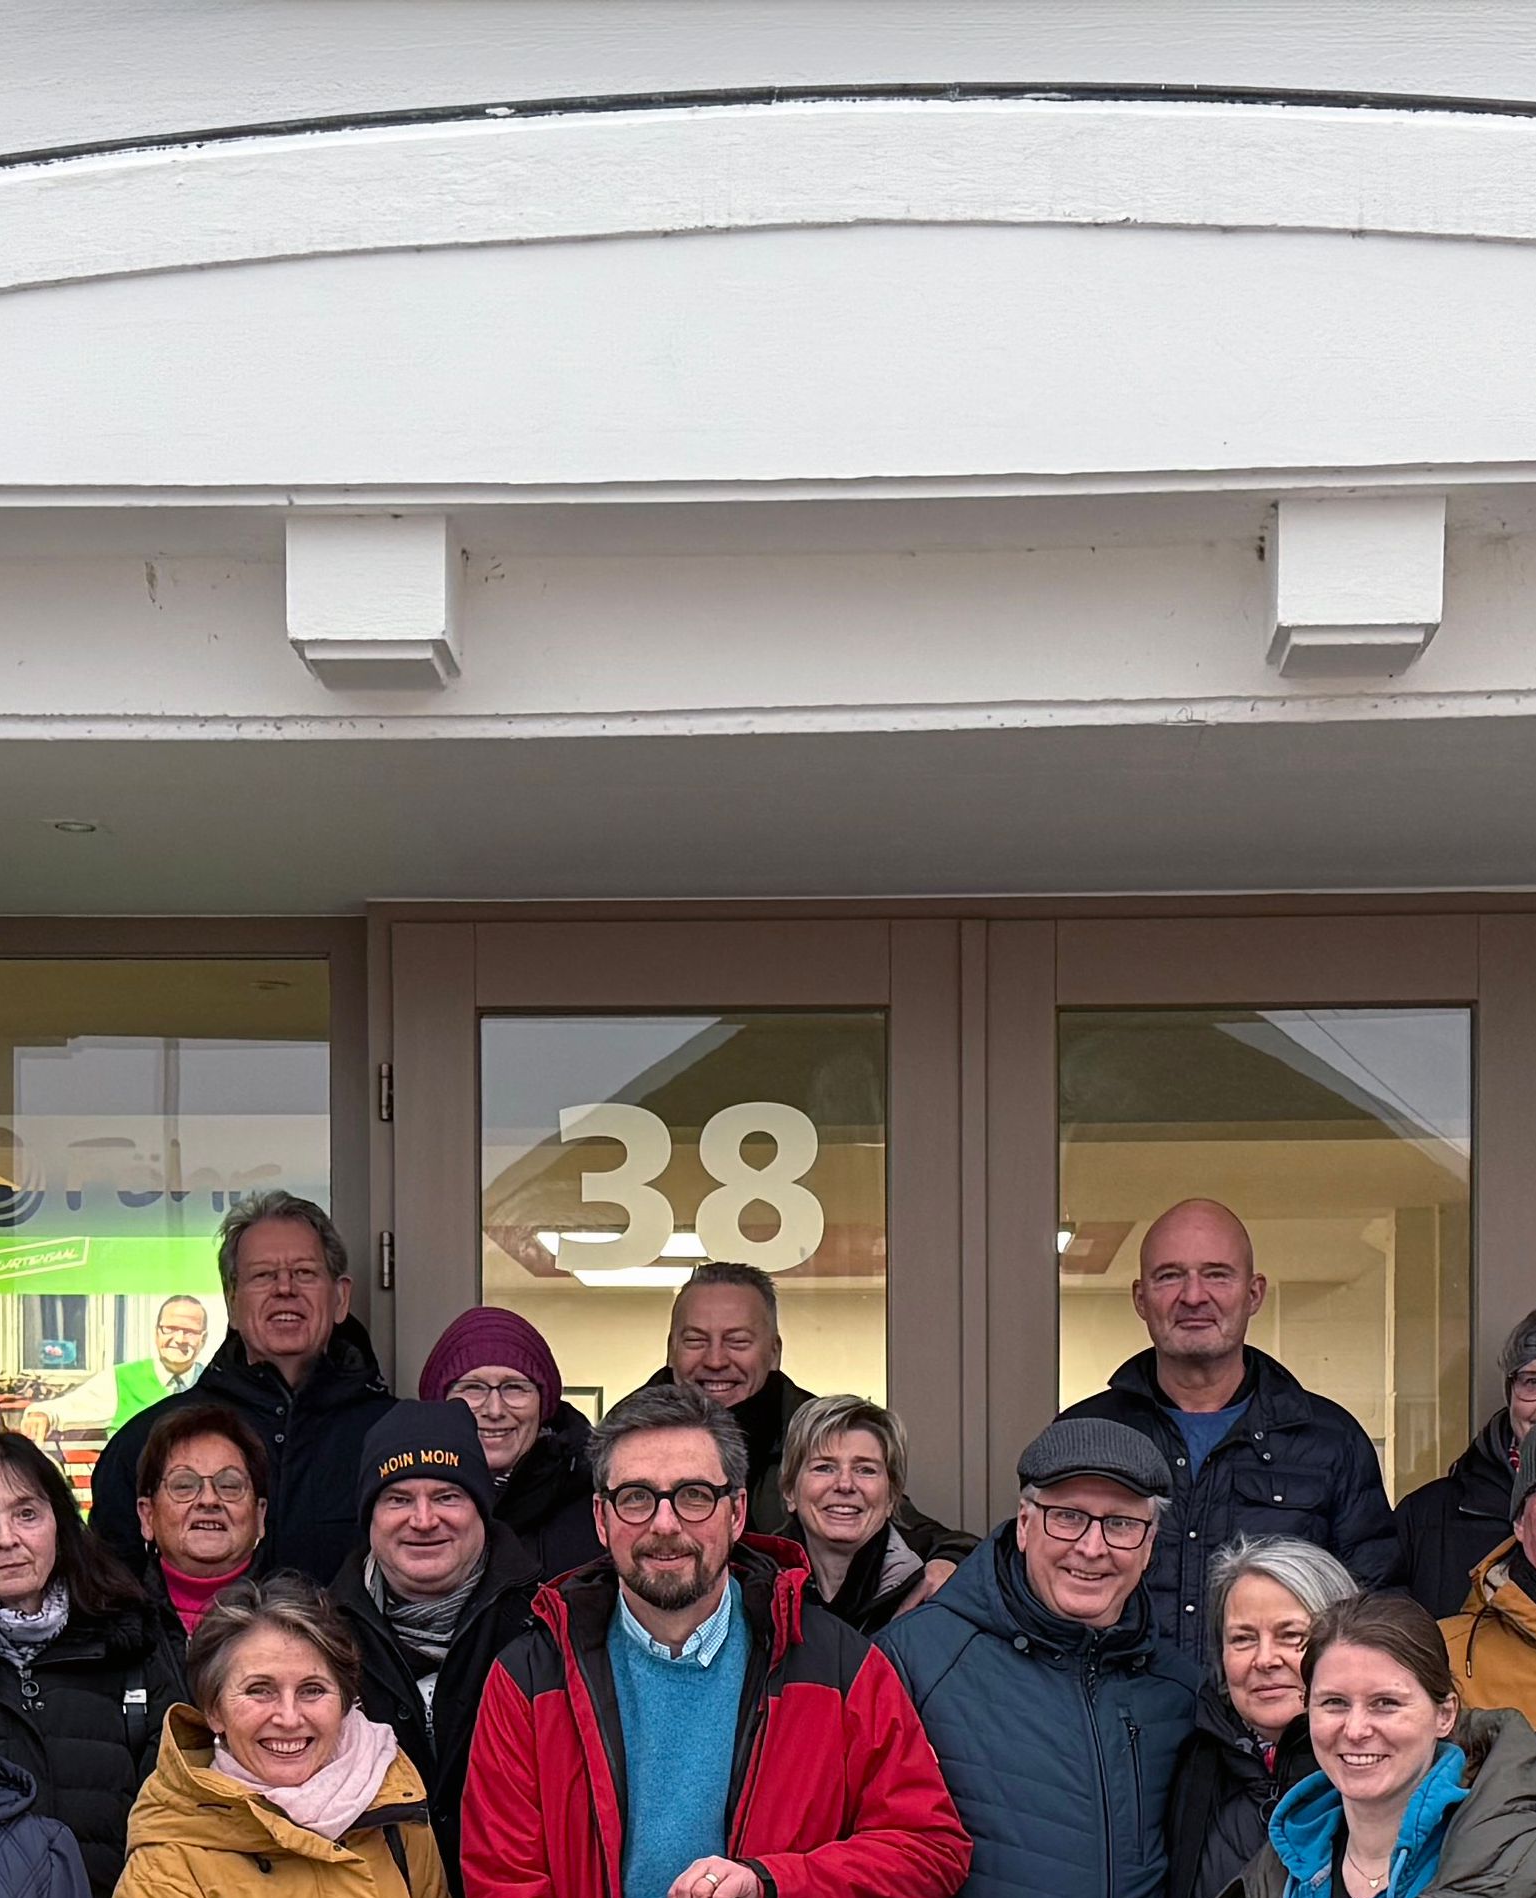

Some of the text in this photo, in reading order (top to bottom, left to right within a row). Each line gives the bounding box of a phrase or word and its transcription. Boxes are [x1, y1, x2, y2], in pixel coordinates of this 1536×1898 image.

[555, 1101, 825, 1274] 38
[378, 1449, 460, 1478] MOIN MOIN
